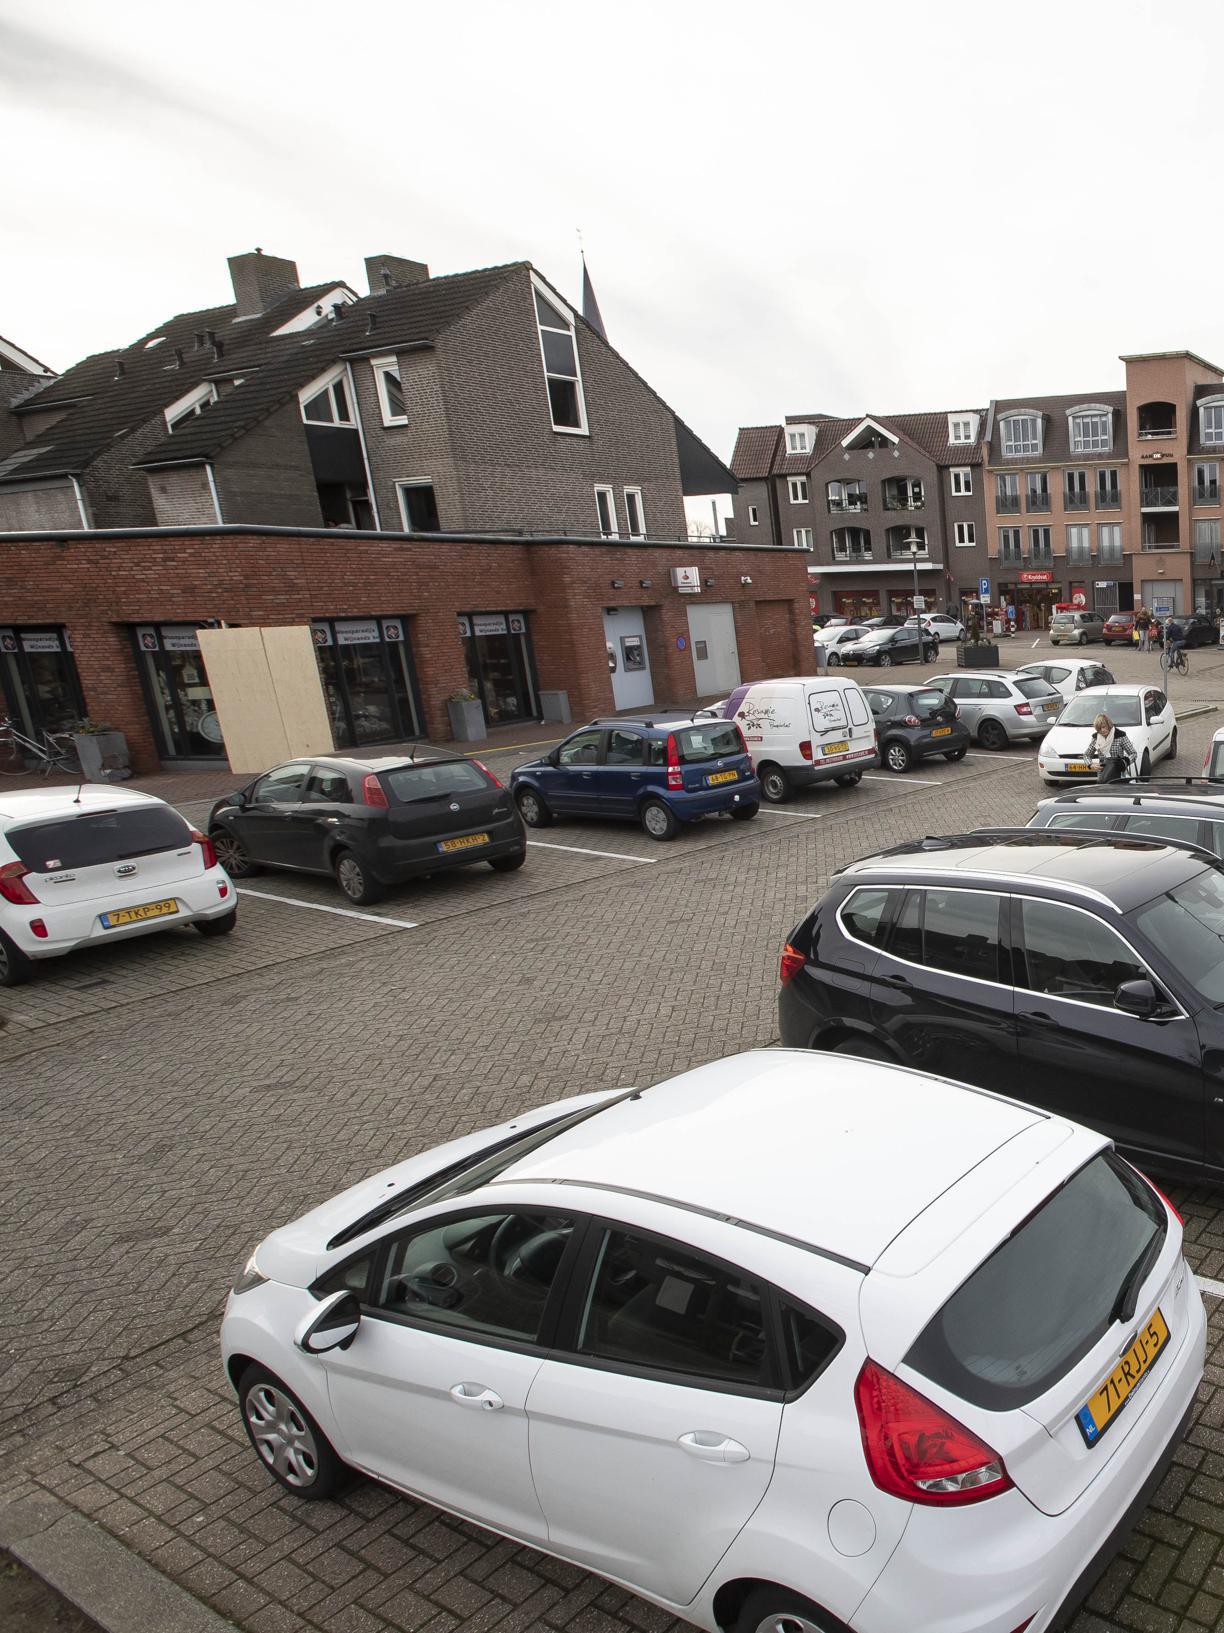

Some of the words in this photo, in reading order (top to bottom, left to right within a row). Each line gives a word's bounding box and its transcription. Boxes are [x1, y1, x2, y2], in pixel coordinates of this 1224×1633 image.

[982, 580, 988, 592] P
[444, 833, 486, 850] 58-HKH-2
[113, 902, 172, 923] 7-TKP-99
[1099, 1322, 1160, 1414] 71-RJJ-5
